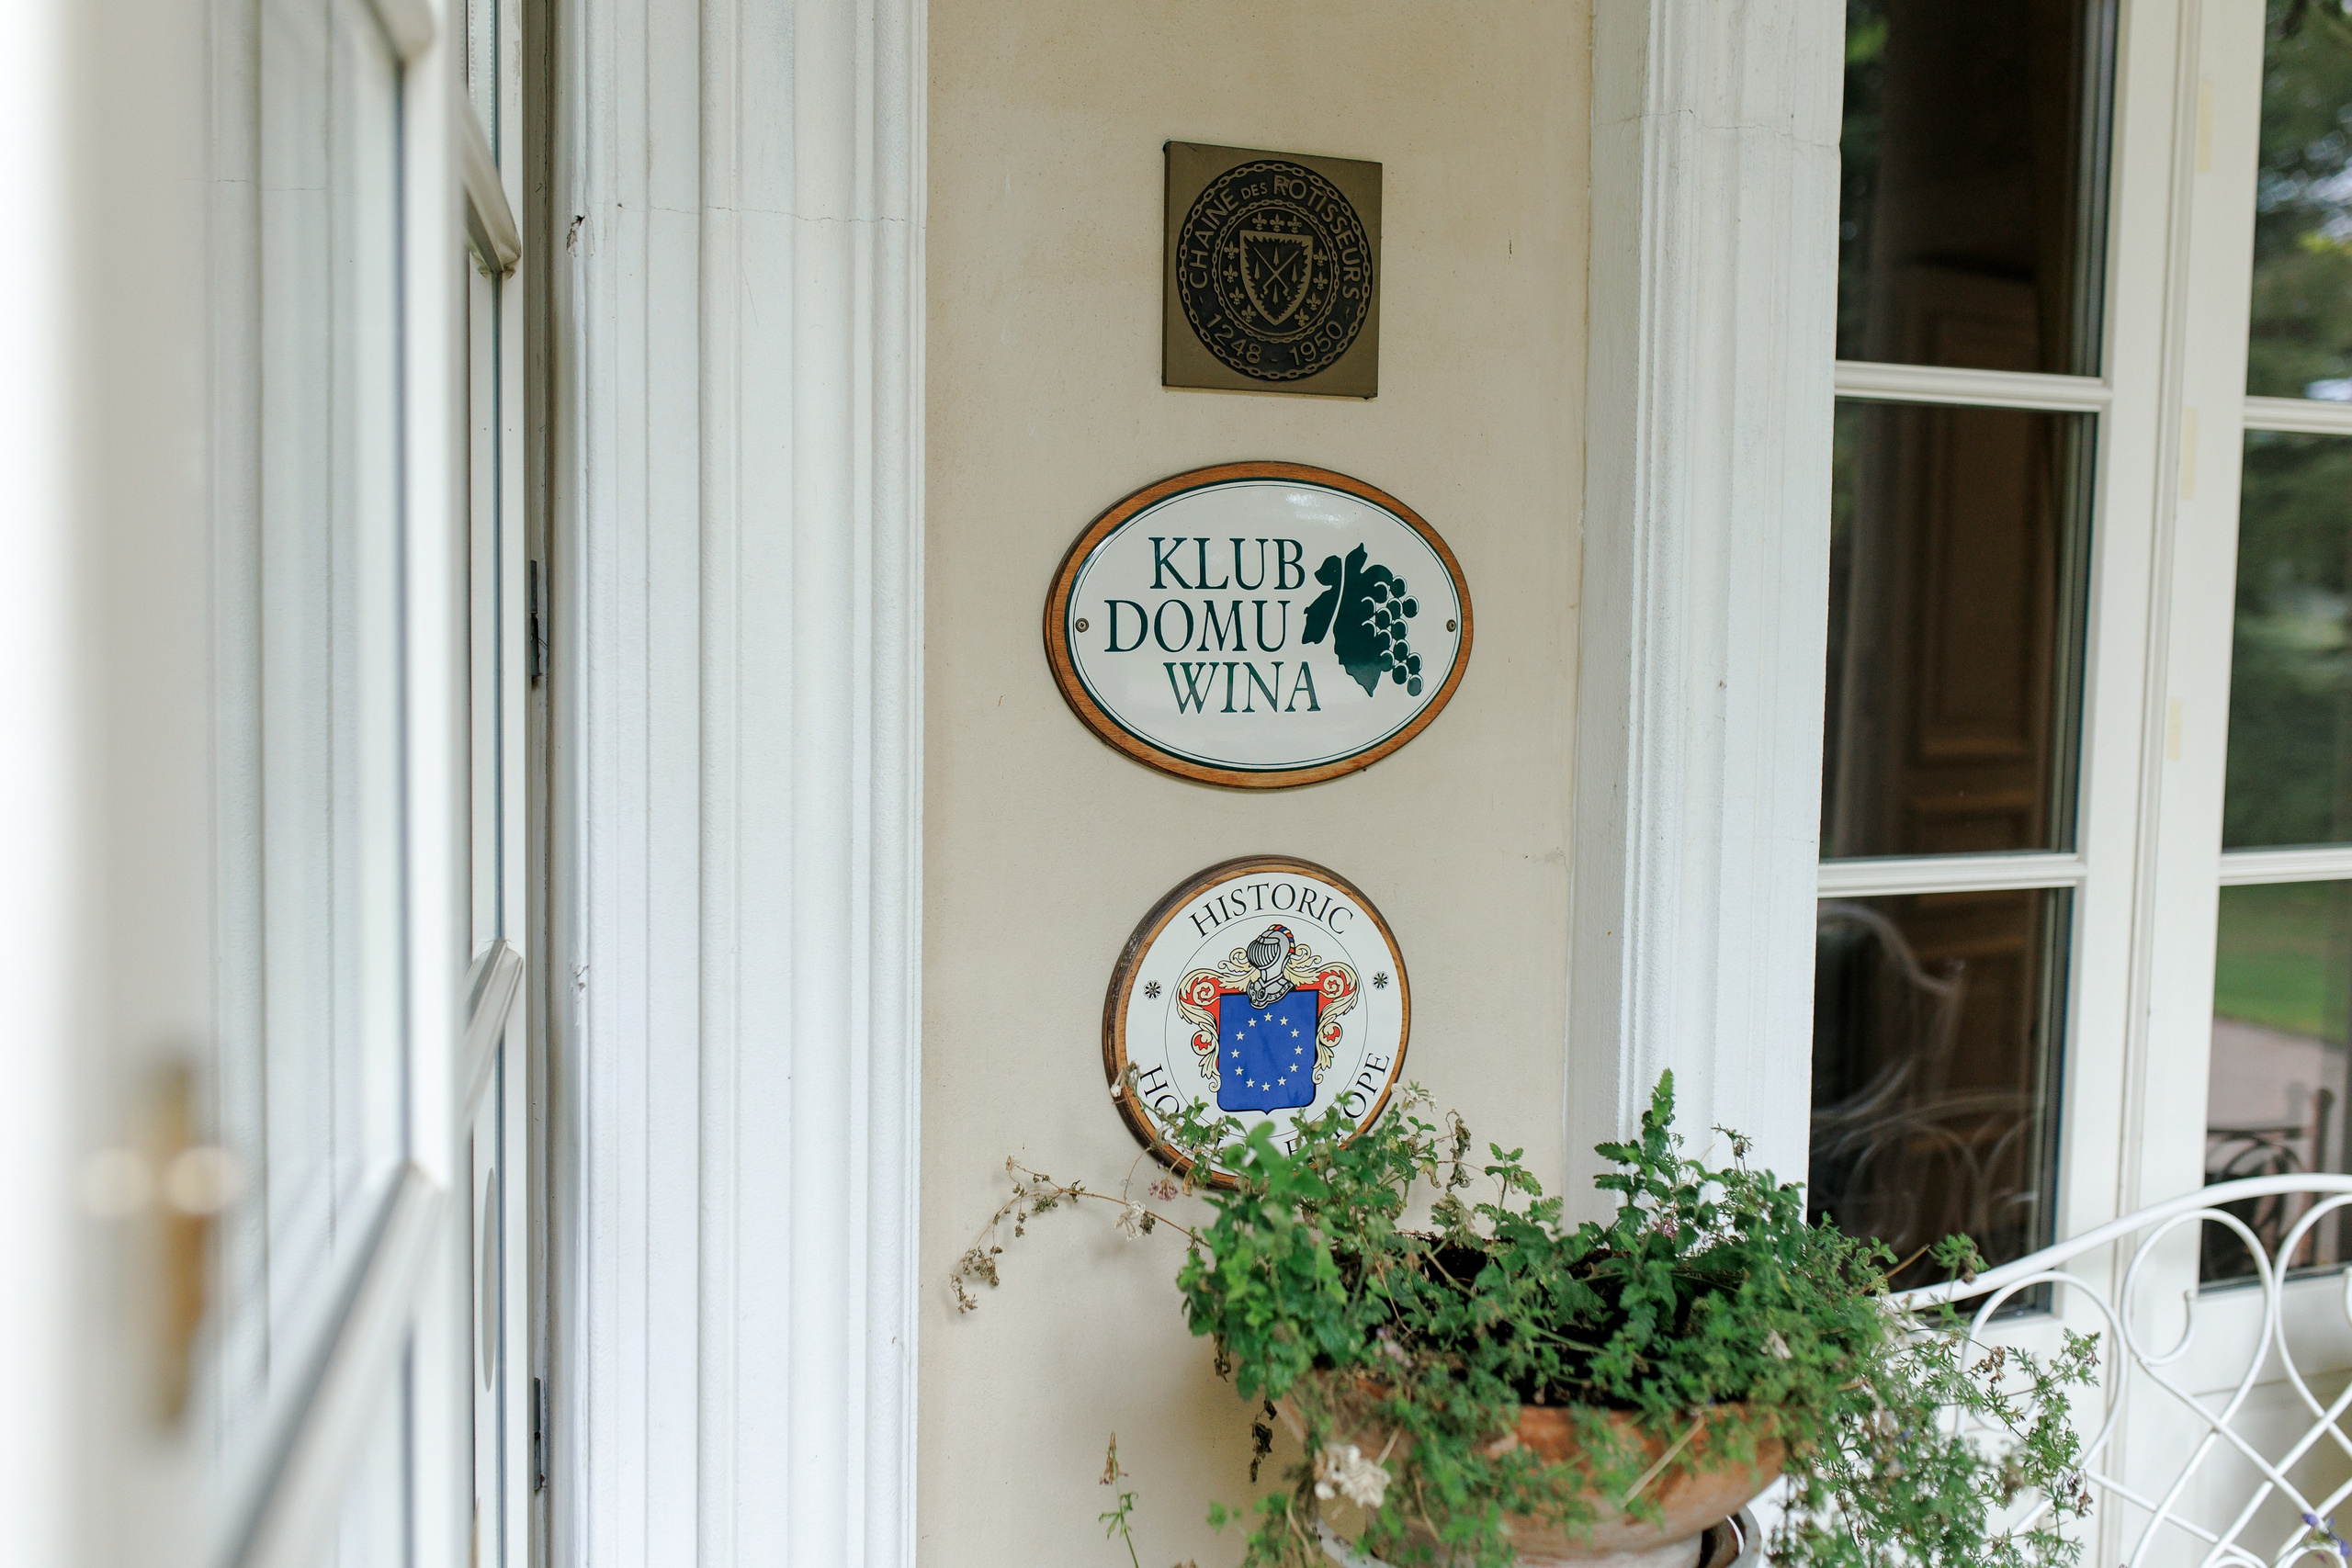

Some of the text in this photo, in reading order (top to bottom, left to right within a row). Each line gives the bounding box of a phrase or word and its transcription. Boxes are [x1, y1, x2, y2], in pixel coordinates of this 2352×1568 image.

[1190, 175, 1361, 300] CHAINE DES ROTISSEURS
[1205, 313, 1262, 365] 1248
[1288, 320, 1343, 367] 1950
[1148, 536, 1306, 591] KLUB
[1102, 599, 1292, 653] DOMU
[1163, 660, 1321, 716] WINA
[1189, 882, 1354, 939] HISTORIC
